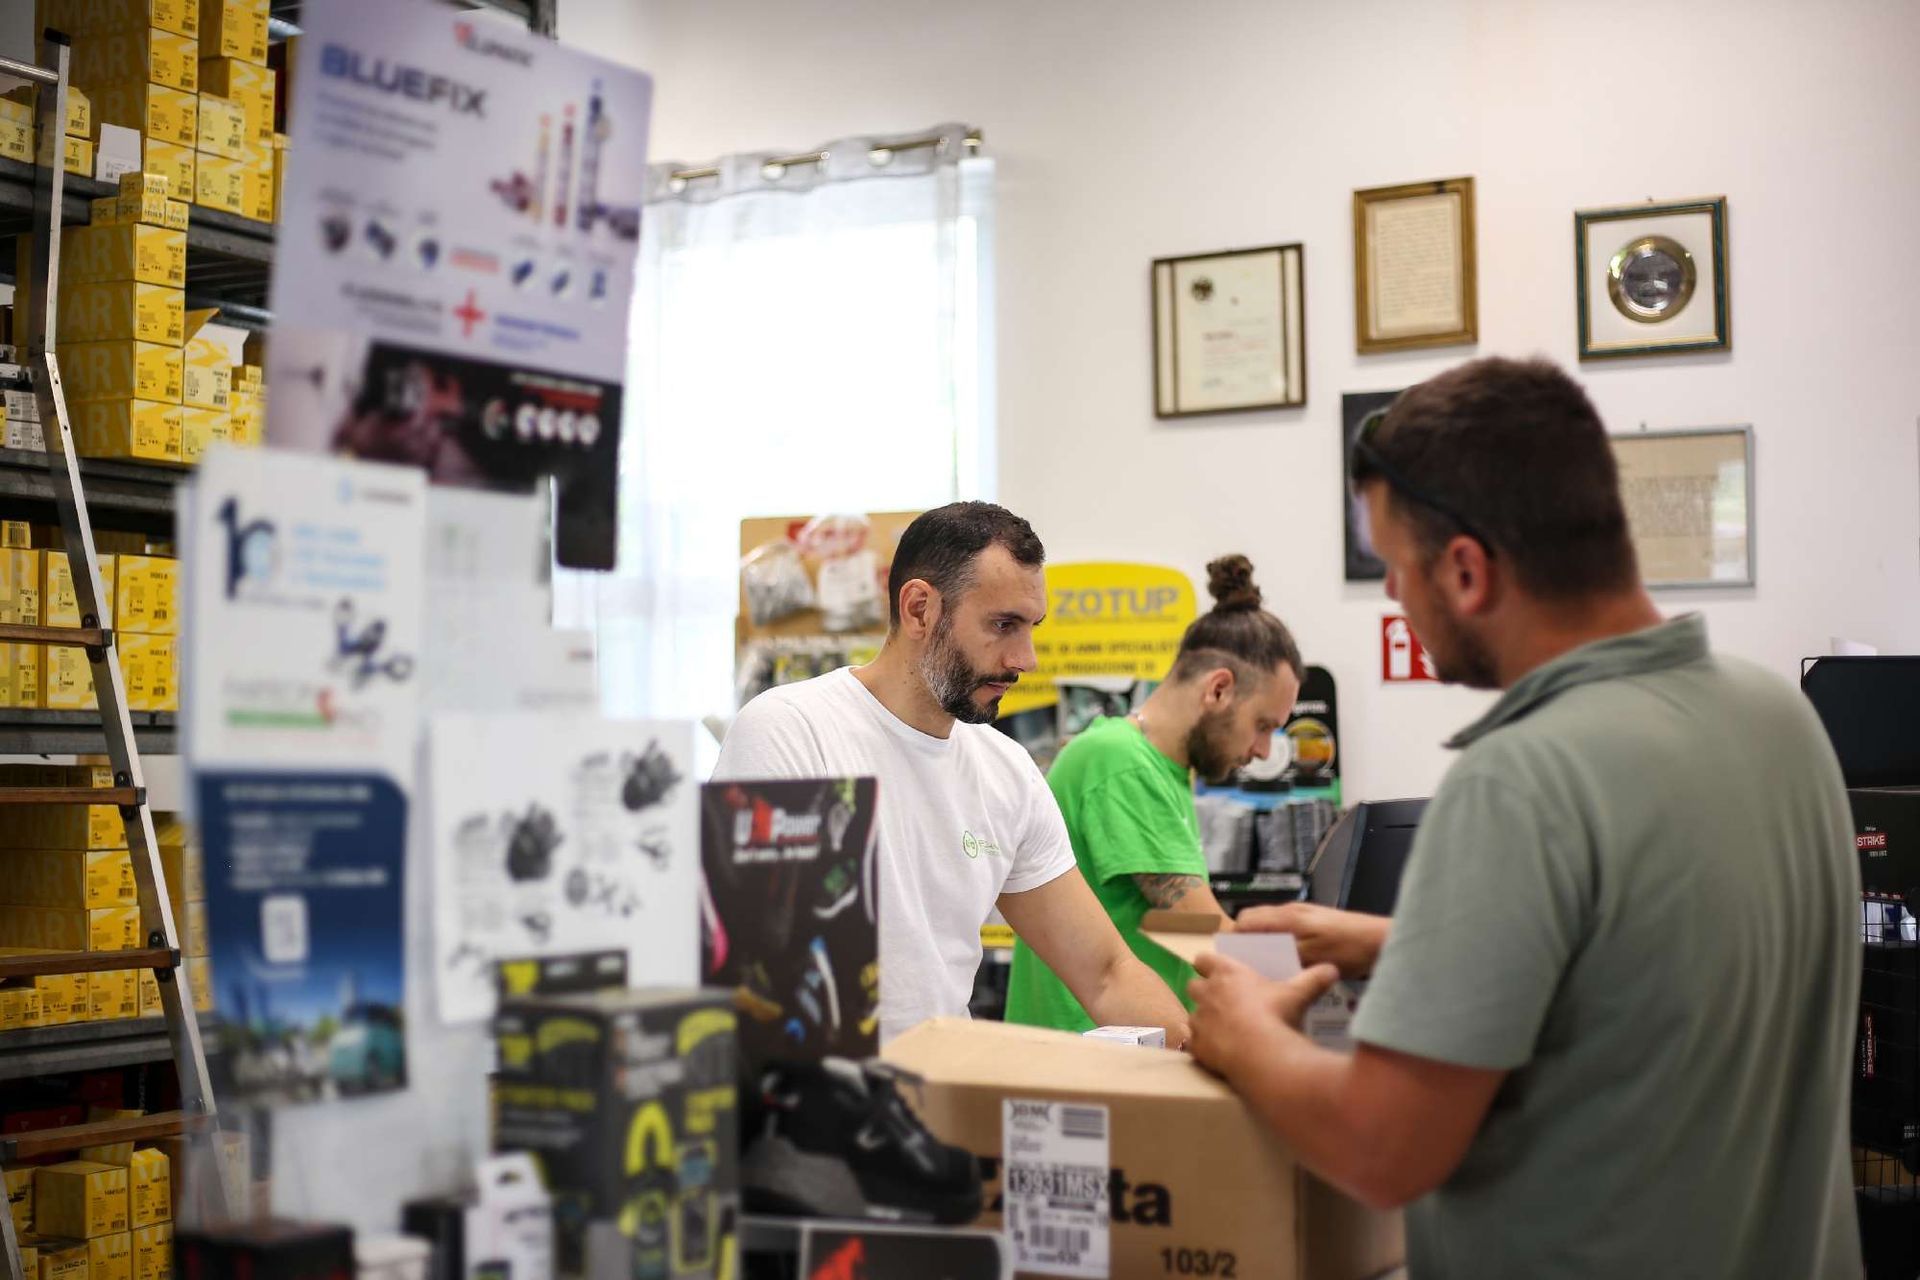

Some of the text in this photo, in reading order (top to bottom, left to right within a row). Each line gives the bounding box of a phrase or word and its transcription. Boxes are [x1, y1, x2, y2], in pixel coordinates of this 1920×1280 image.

[321, 43, 487, 118] BLUEFIX
[1055, 587, 1178, 617] ZOTUP
[1857, 836, 1885, 846] STRIKE
[1161, 1246, 1237, 1278] 103/2
